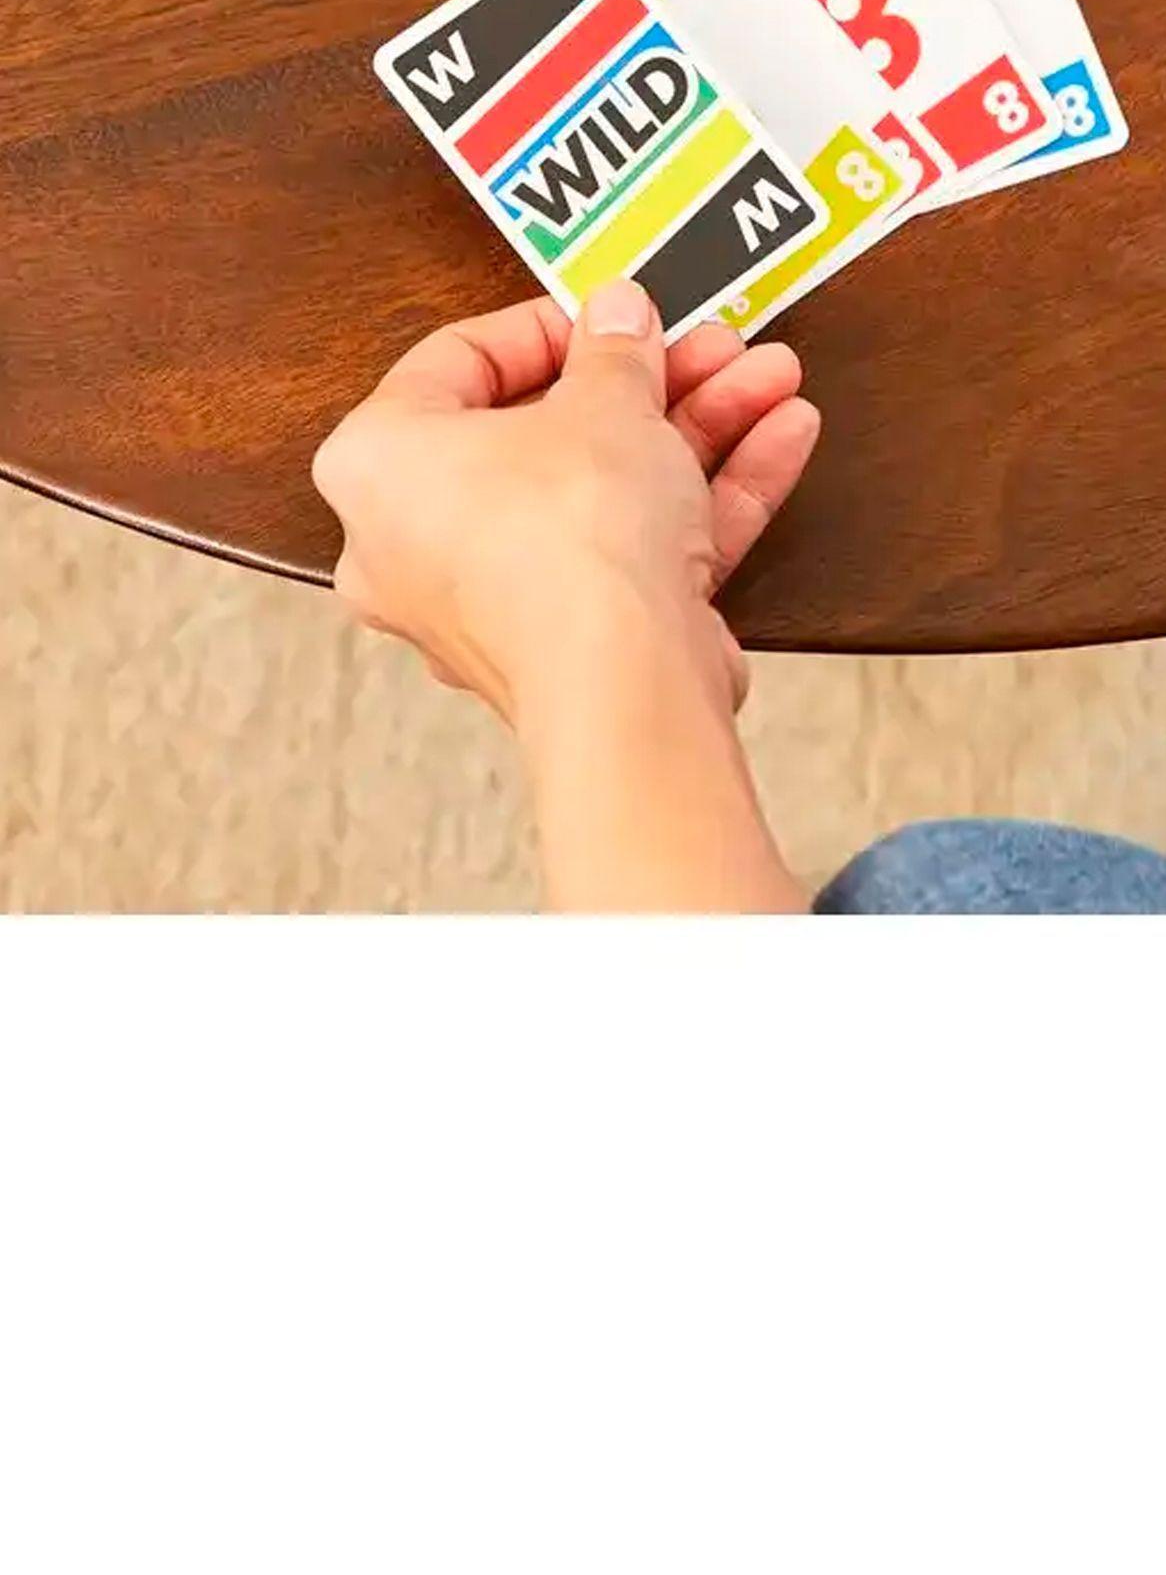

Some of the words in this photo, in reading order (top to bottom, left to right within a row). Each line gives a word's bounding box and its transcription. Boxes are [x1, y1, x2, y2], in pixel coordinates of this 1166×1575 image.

[407, 33, 476, 106] W
[982, 80, 1029, 134] 8
[1054, 83, 1096, 138] 8
[510, 55, 690, 227] WILD
[835, 150, 886, 202] 8
[731, 177, 803, 253] W
